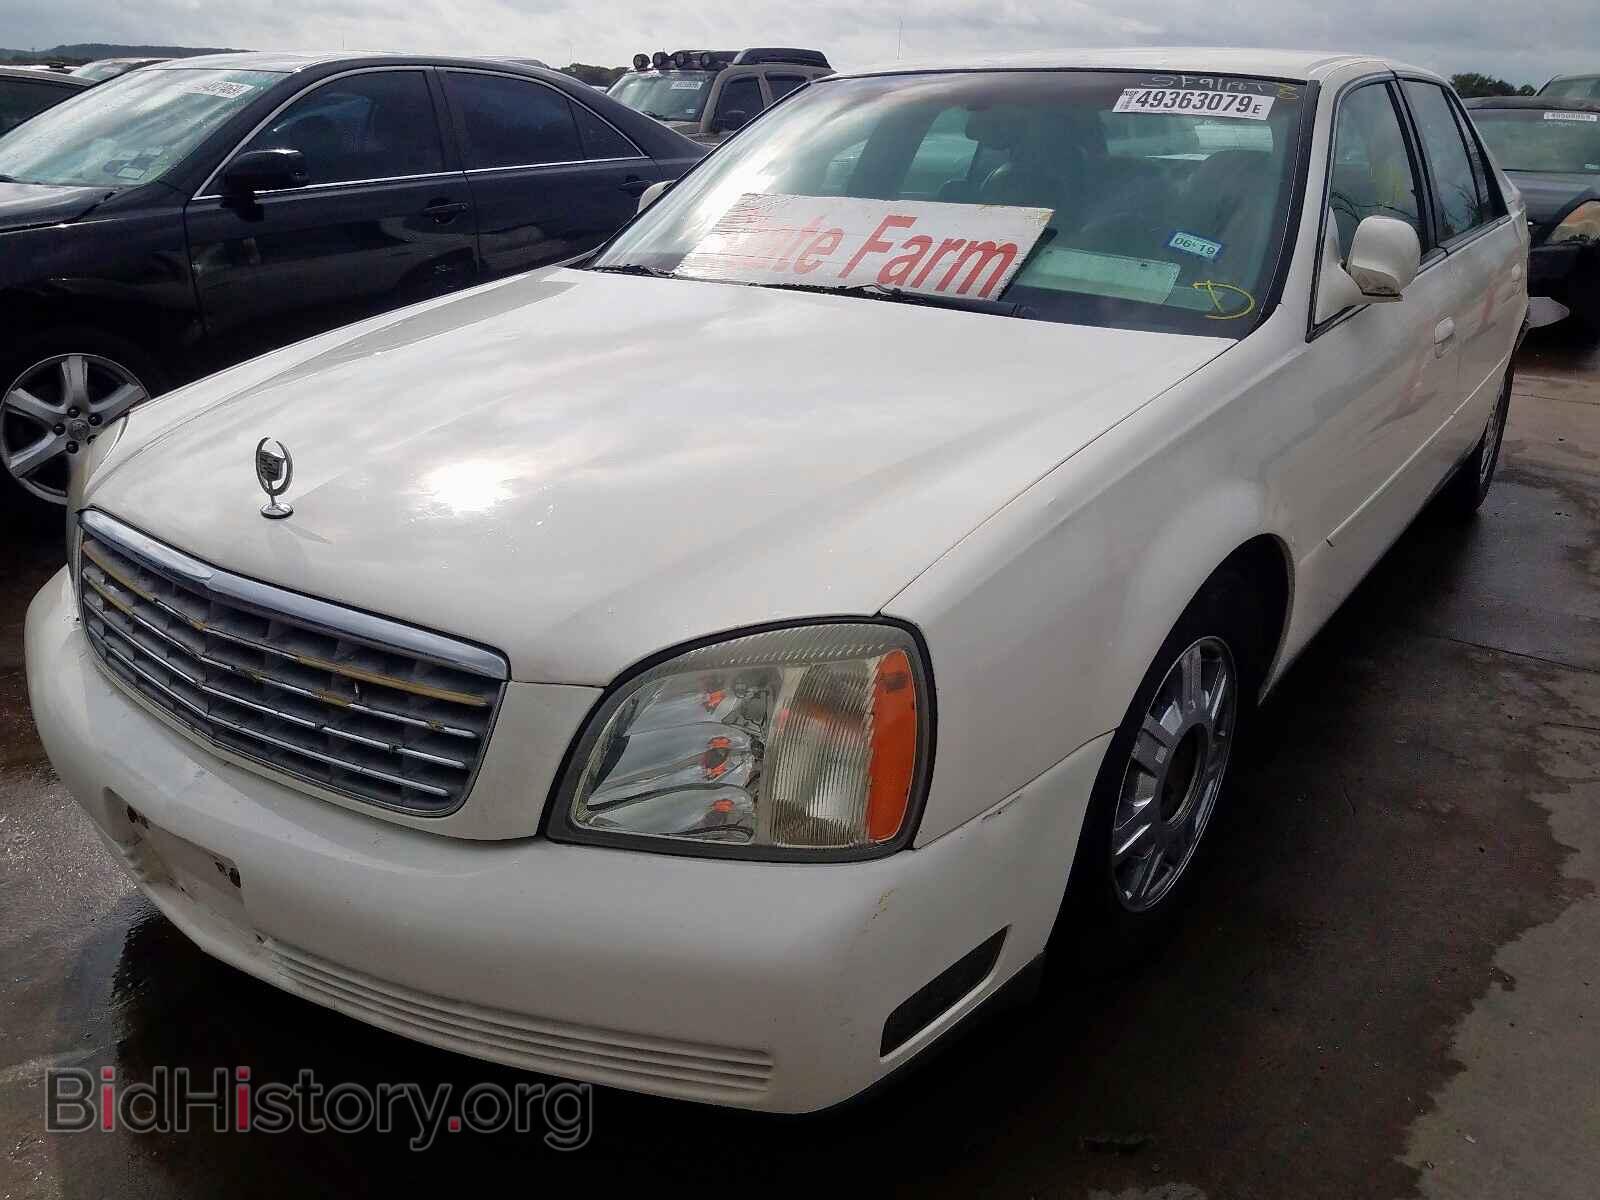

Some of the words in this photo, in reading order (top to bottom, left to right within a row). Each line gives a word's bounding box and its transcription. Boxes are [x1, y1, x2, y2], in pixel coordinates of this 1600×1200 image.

[1135, 90, 1253, 113] 49363079
[1252, 104, 1263, 114] E
[837, 214, 1018, 299] Farm
